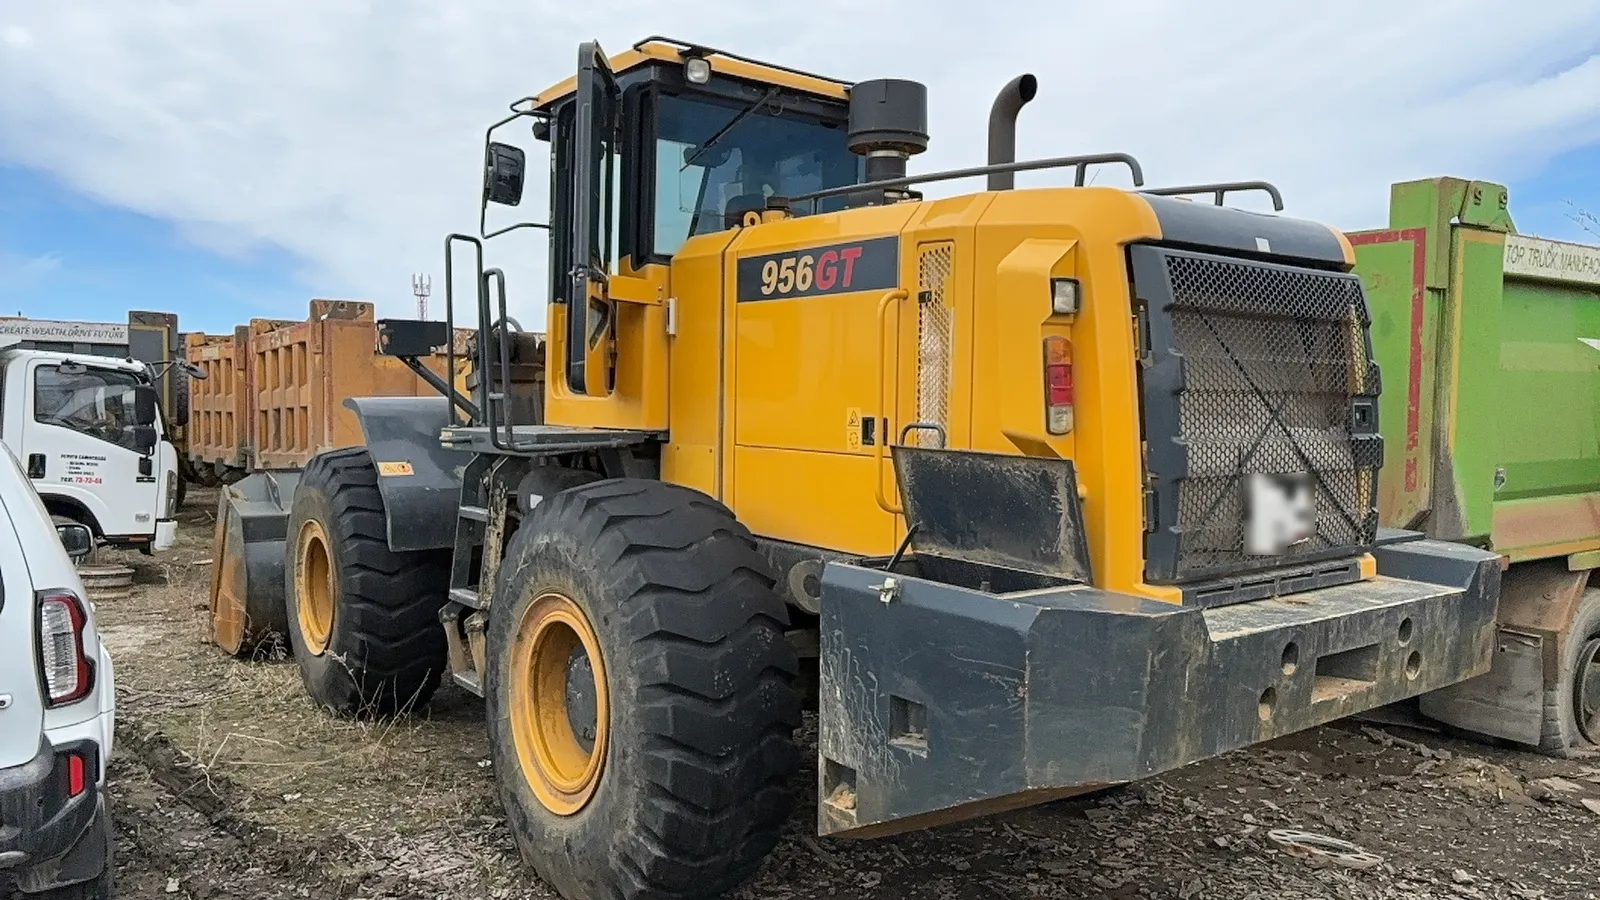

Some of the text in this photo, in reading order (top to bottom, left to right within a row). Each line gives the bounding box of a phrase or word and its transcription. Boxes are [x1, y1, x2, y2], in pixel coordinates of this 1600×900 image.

[1506, 244, 1525, 265] TOP
[1528, 247, 1559, 270] TRUCK
[760, 247, 863, 295] 956GT
[0, 325, 30, 335] CREATE
[94, 329, 125, 339] FUTURE
